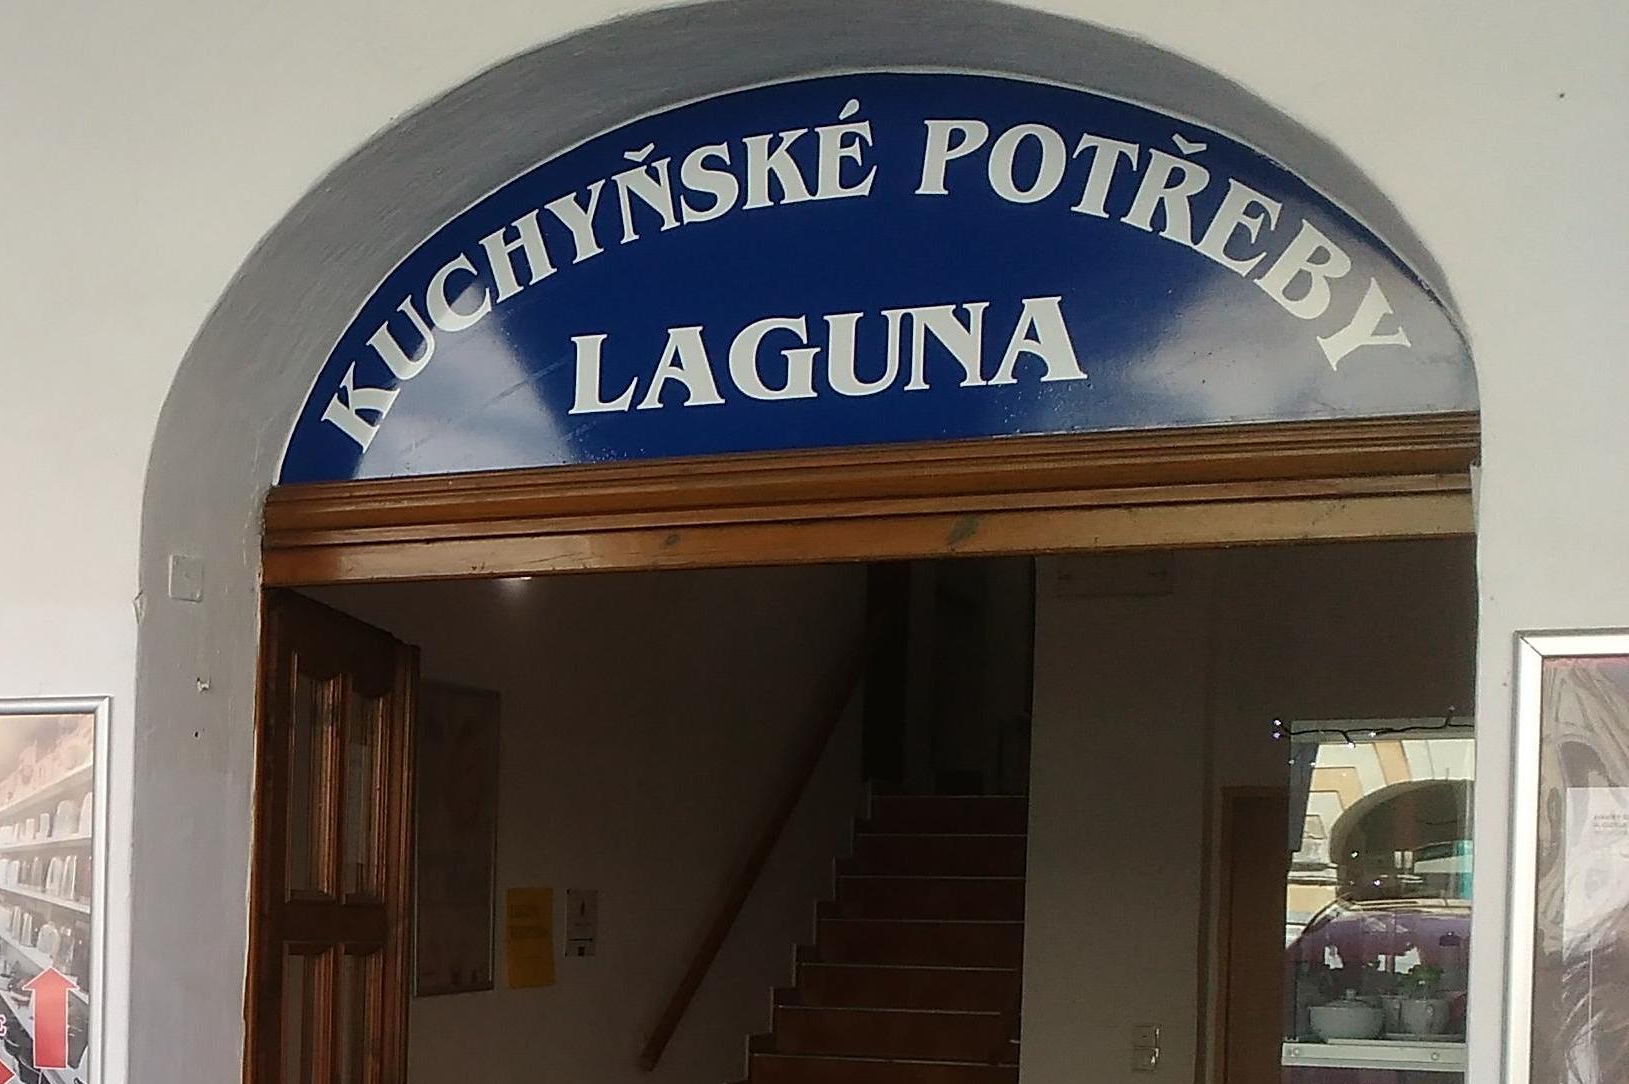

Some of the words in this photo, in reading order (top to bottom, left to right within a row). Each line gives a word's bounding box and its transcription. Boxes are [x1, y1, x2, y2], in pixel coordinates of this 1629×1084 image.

[321, 98, 875, 454] KUCHYŇSKÉ
[915, 117, 1411, 371] POTŘEBY
[569, 295, 1088, 416] LAGUNA
